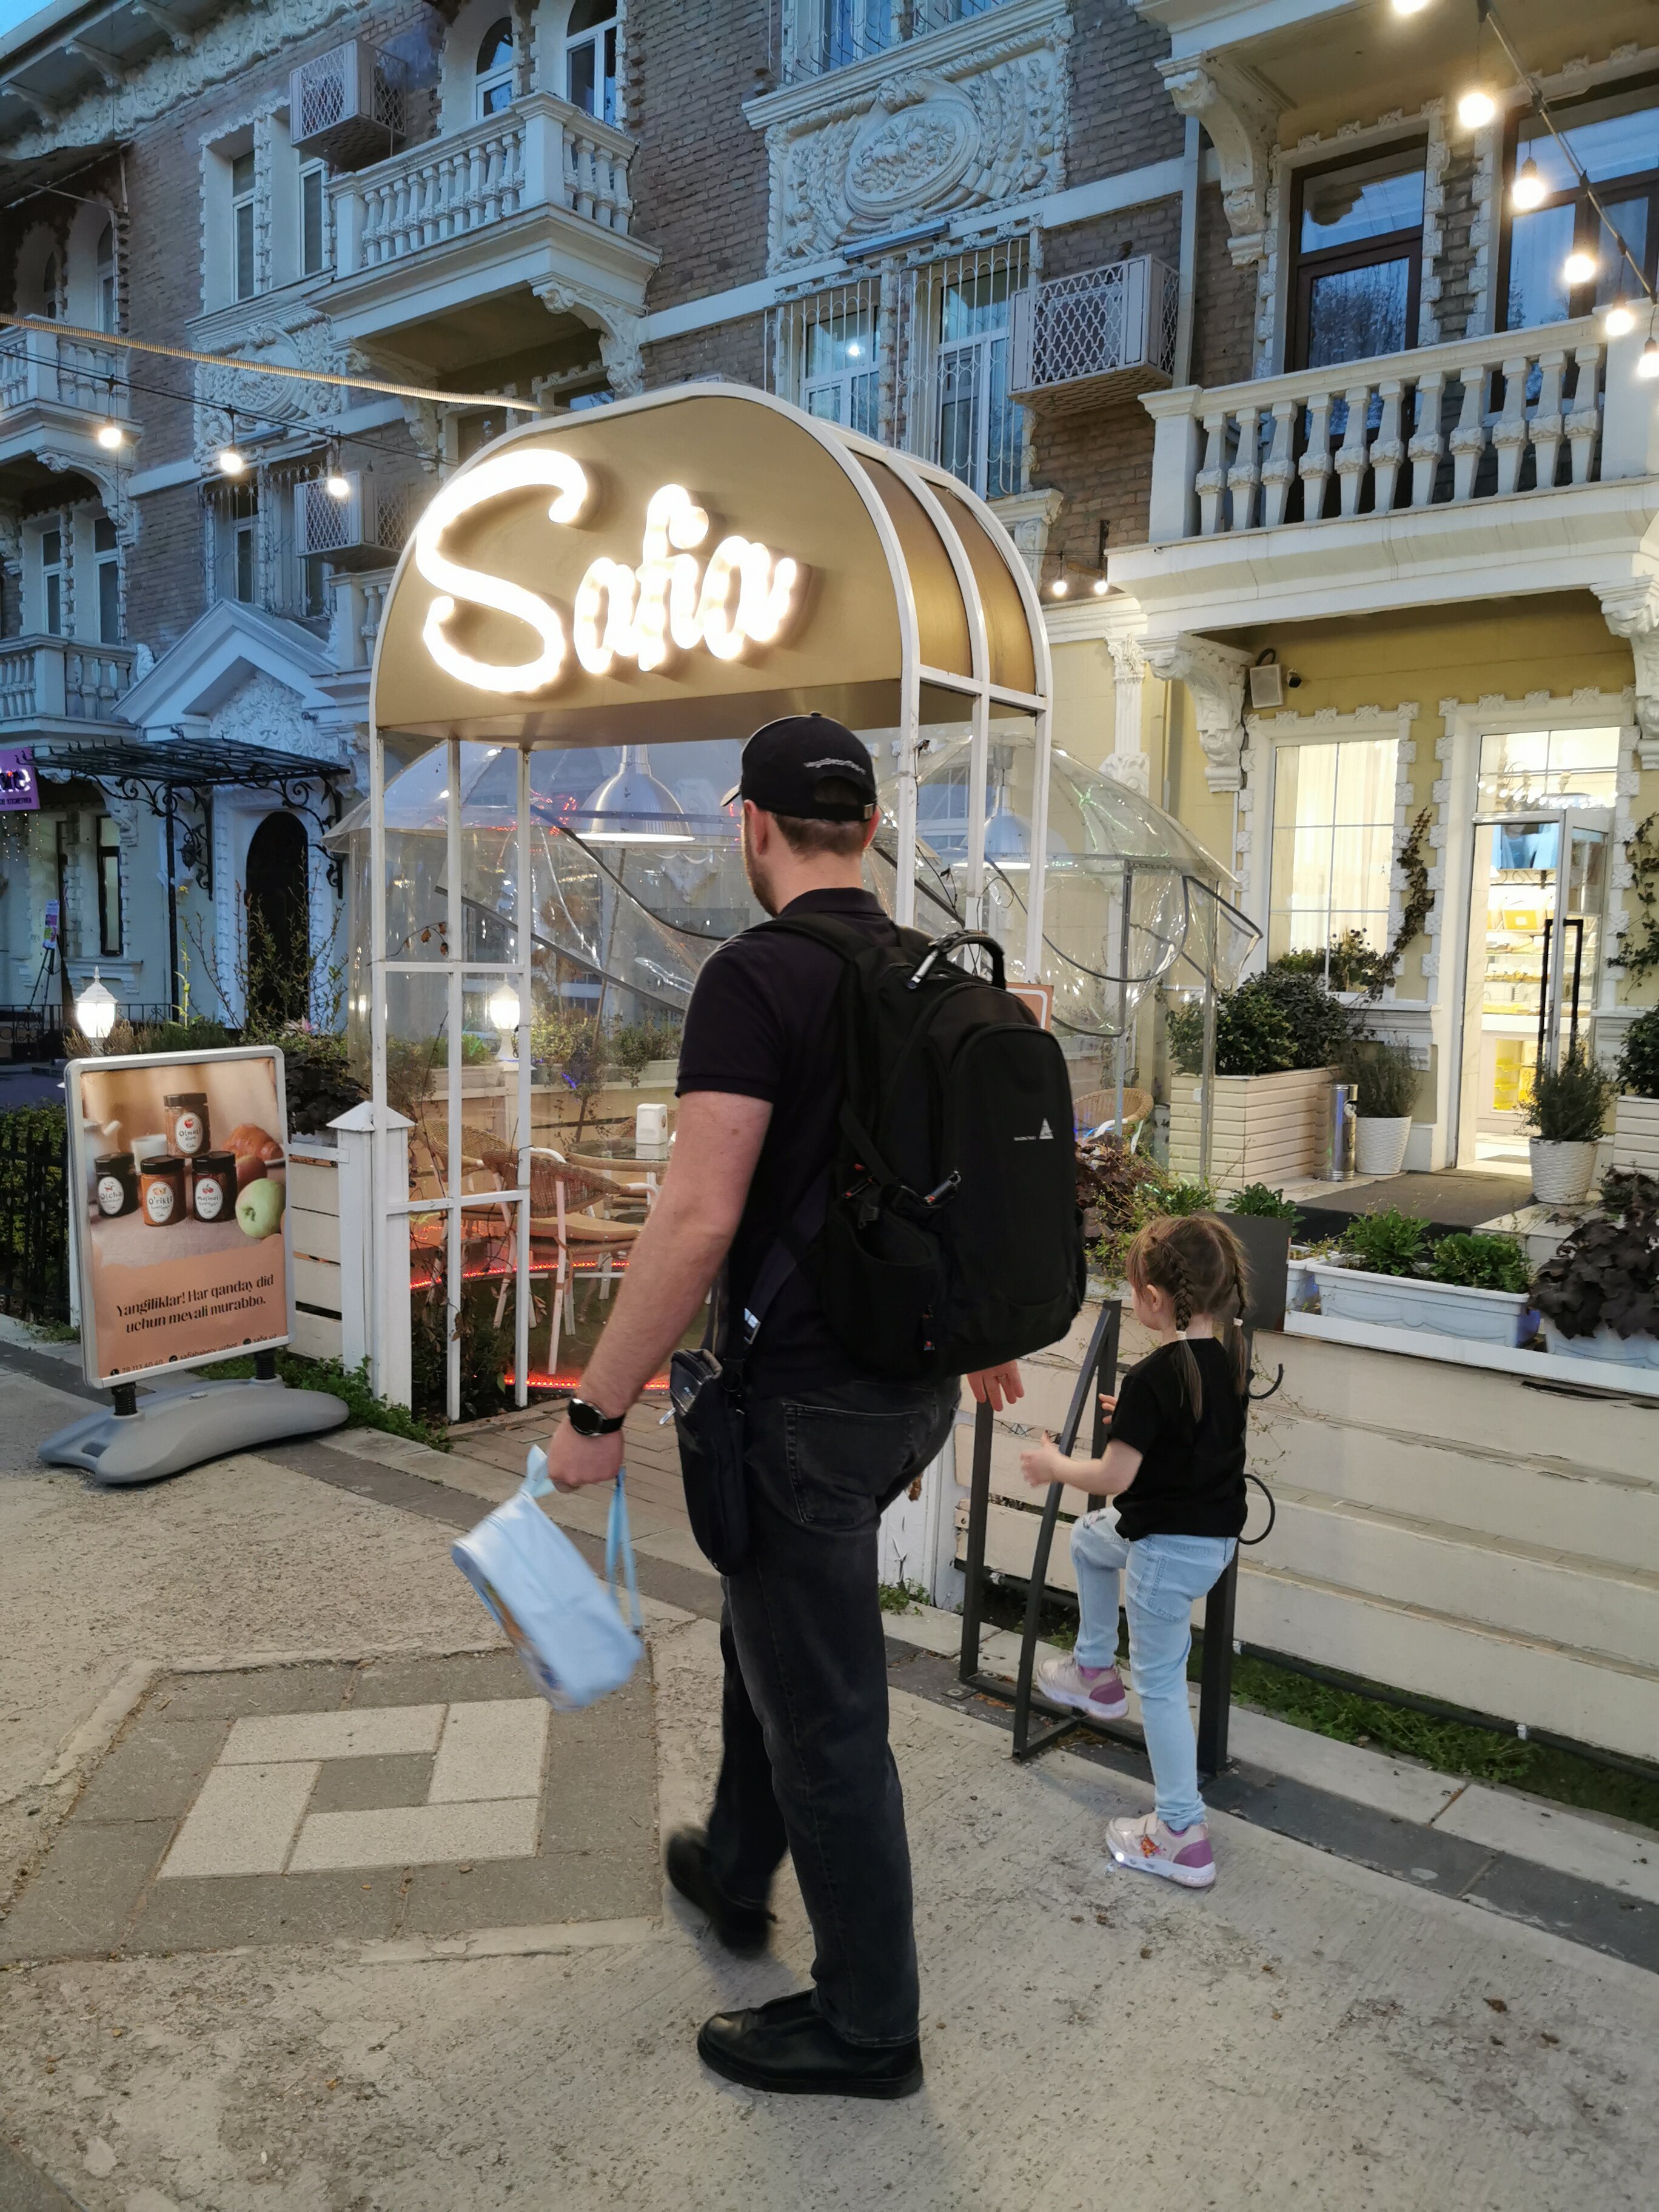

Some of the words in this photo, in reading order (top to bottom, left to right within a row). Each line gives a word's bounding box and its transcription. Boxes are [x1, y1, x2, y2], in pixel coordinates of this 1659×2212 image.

[116, 1292, 186, 1317] Yangiliklar!
[188, 1289, 209, 1302] Har
[210, 1280, 253, 1298] qanday
[256, 1274, 274, 1288] did
[126, 1316, 166, 1333] uchun
[169, 1305, 209, 1324] mevali
[210, 1295, 266, 1315] murabbo.
